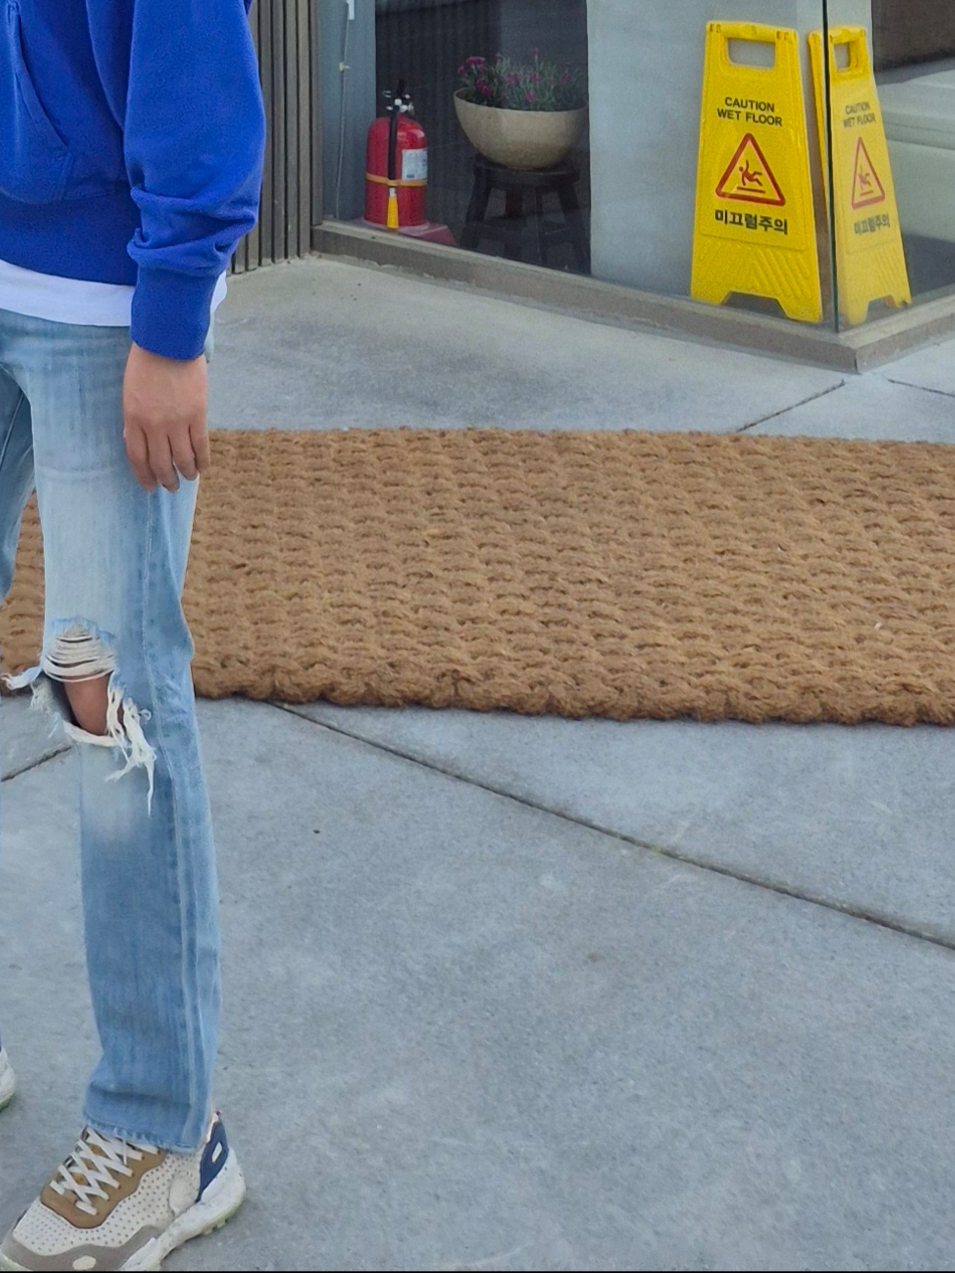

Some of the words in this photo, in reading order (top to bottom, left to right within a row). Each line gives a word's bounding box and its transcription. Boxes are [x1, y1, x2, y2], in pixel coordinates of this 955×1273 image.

[724, 96, 776, 114] CAUTION
[845, 101, 871, 116] CAUTION
[717, 107, 742, 121] WET
[746, 110, 783, 127] FLOOR
[843, 117, 855, 129] WET
[856, 112, 877, 126] FLOOR
[714, 208, 789, 236] 미끄럼주의
[853, 212, 891, 236] 미끄럼주의
